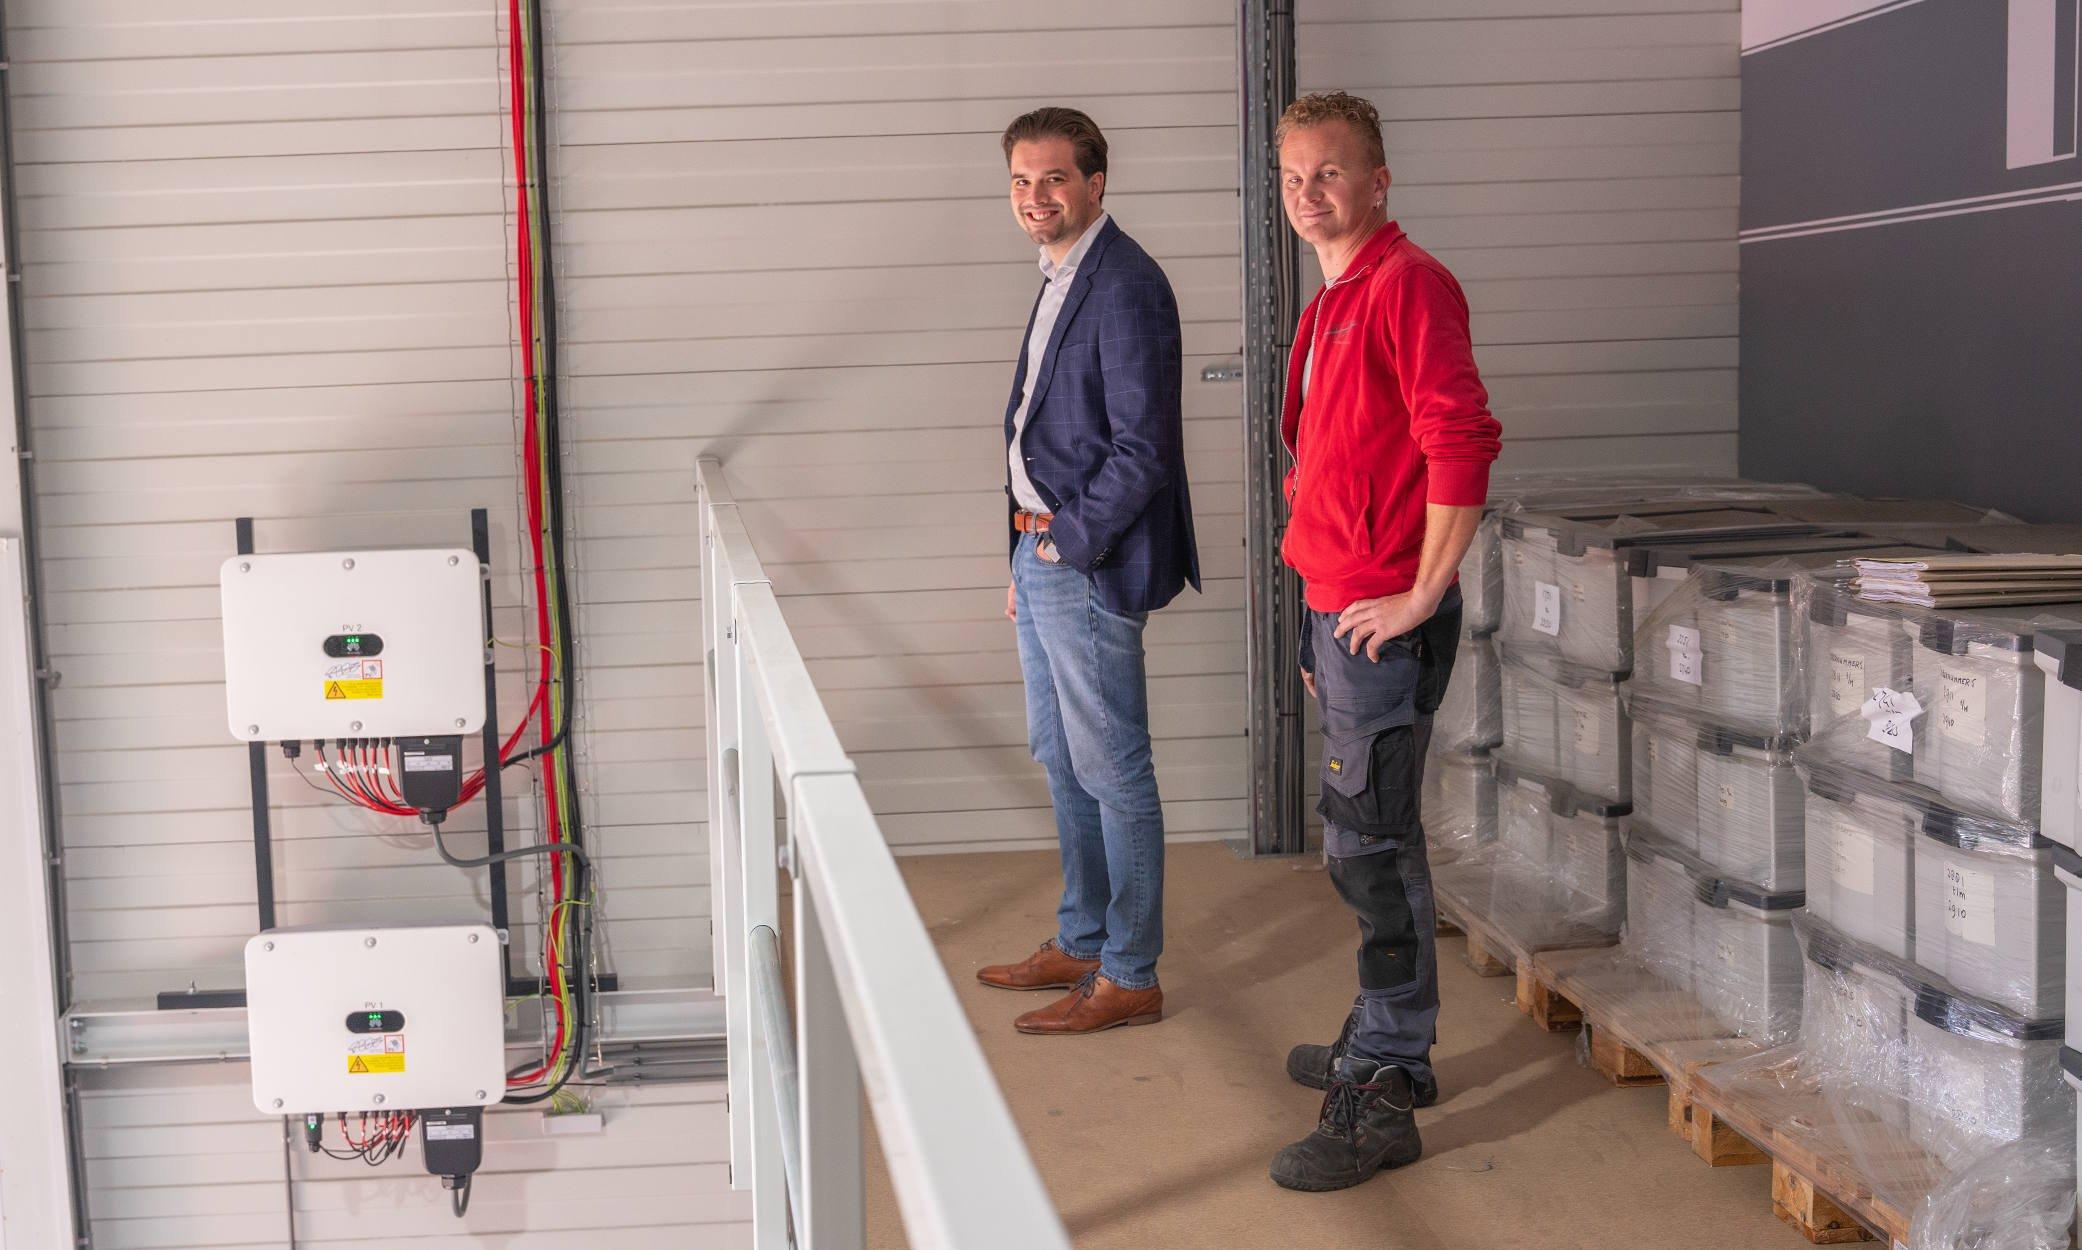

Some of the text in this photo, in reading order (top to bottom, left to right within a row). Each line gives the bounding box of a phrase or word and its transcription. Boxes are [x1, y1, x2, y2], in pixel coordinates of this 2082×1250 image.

[342, 624, 362, 632] PV 2
[364, 1001, 376, 1009] PV
